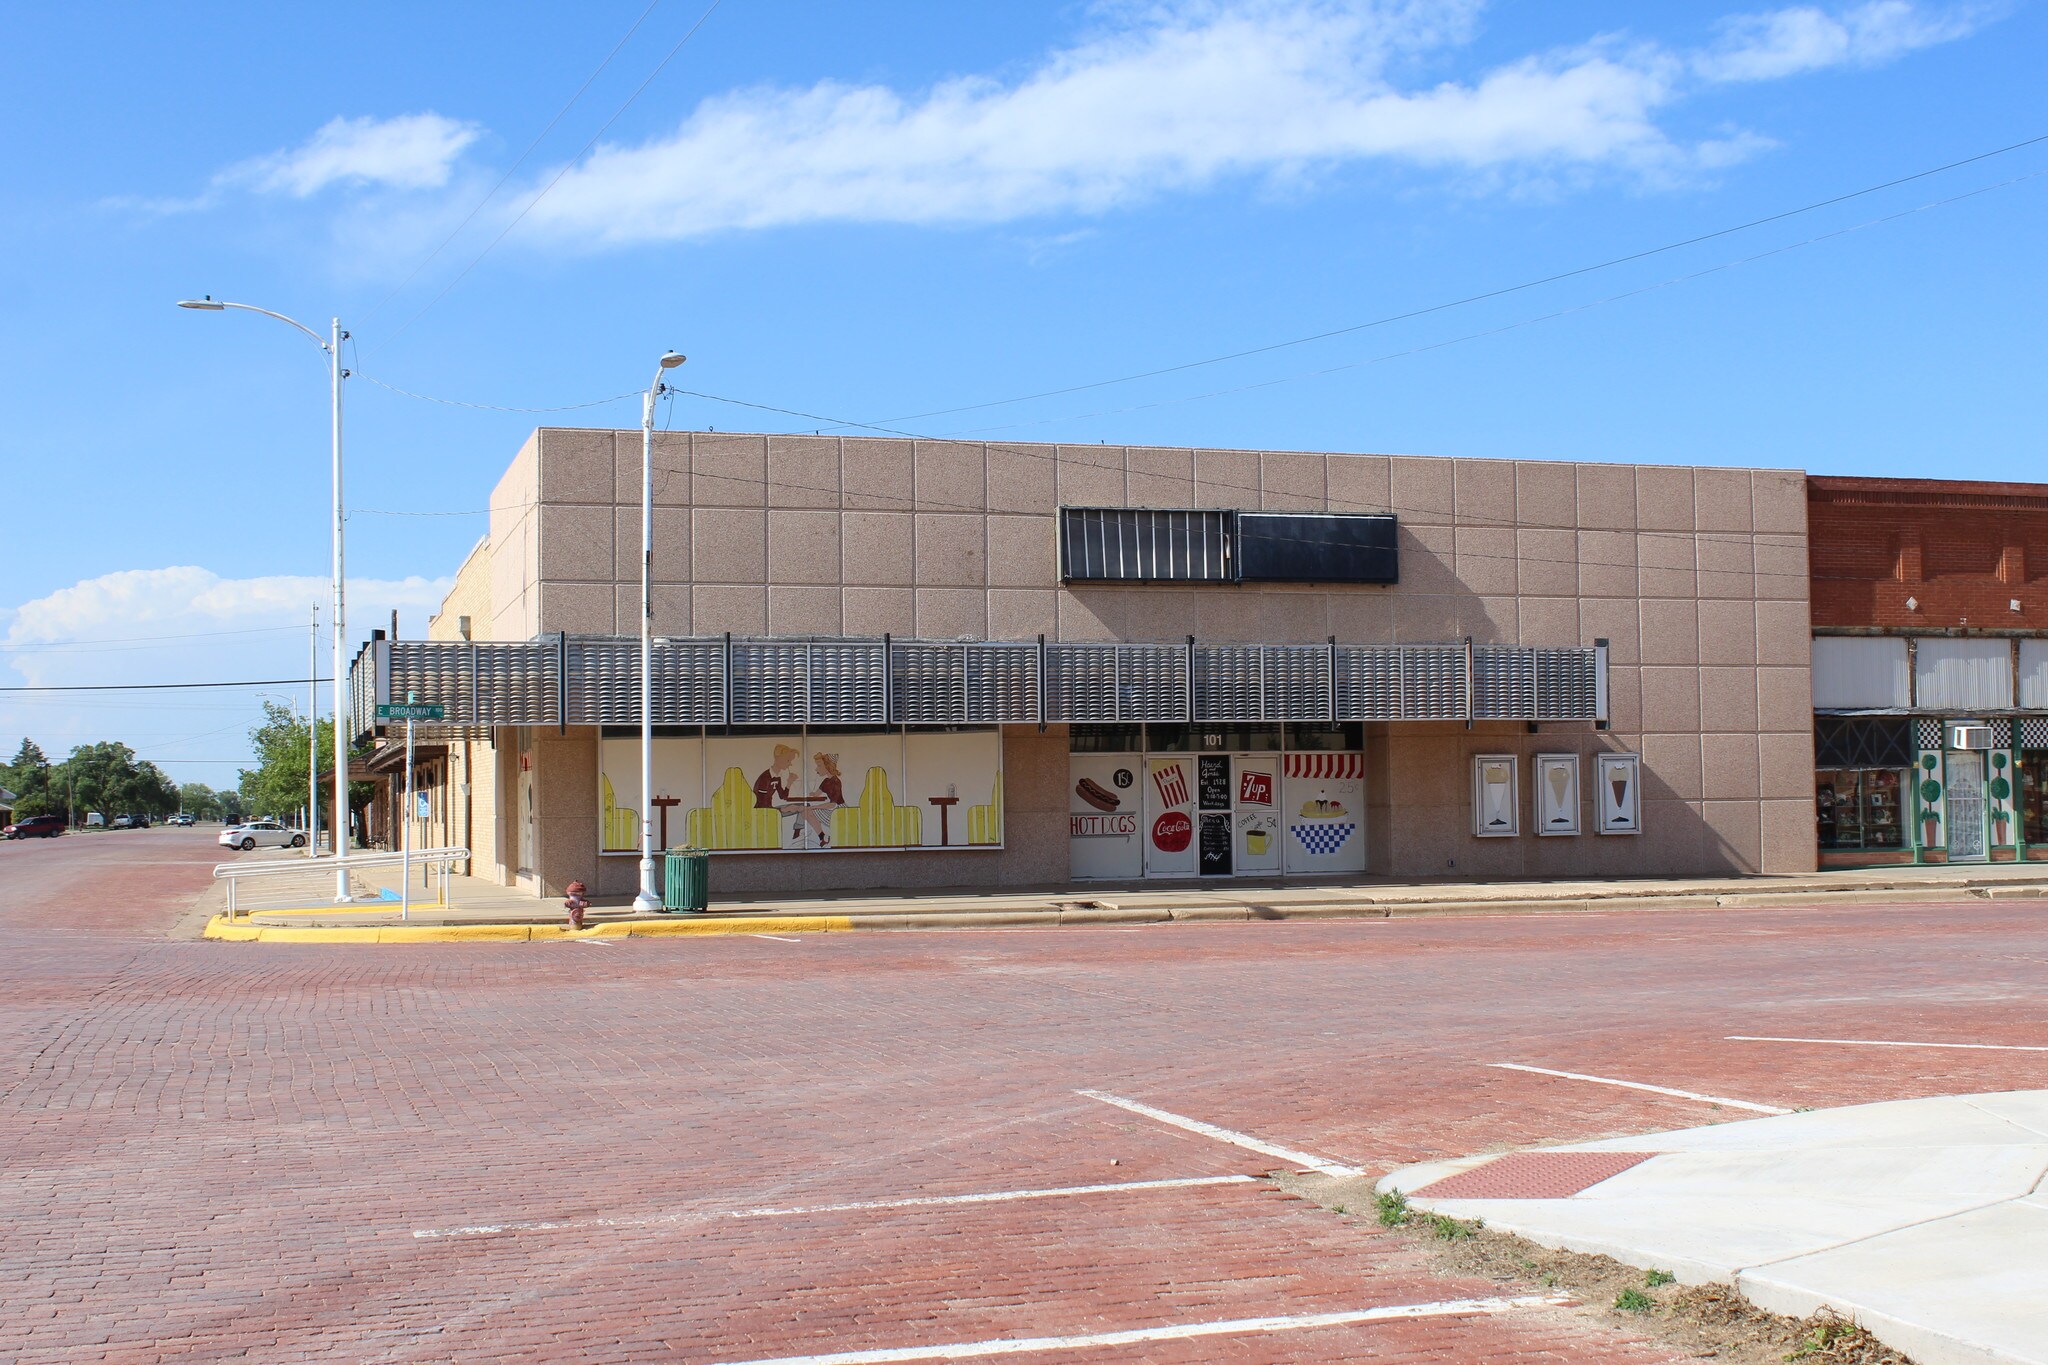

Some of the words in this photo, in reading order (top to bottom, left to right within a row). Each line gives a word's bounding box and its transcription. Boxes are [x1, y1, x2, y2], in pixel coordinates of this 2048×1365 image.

[378, 706, 383, 715] E
[389, 706, 432, 716] BROADWAY
[1203, 734, 1222, 746] 101
[1207, 786, 1221, 794] Open
[1070, 815, 1100, 835] HOT
[1101, 815, 1136, 833] DOGS
[1237, 813, 1257, 828] COFFEE
